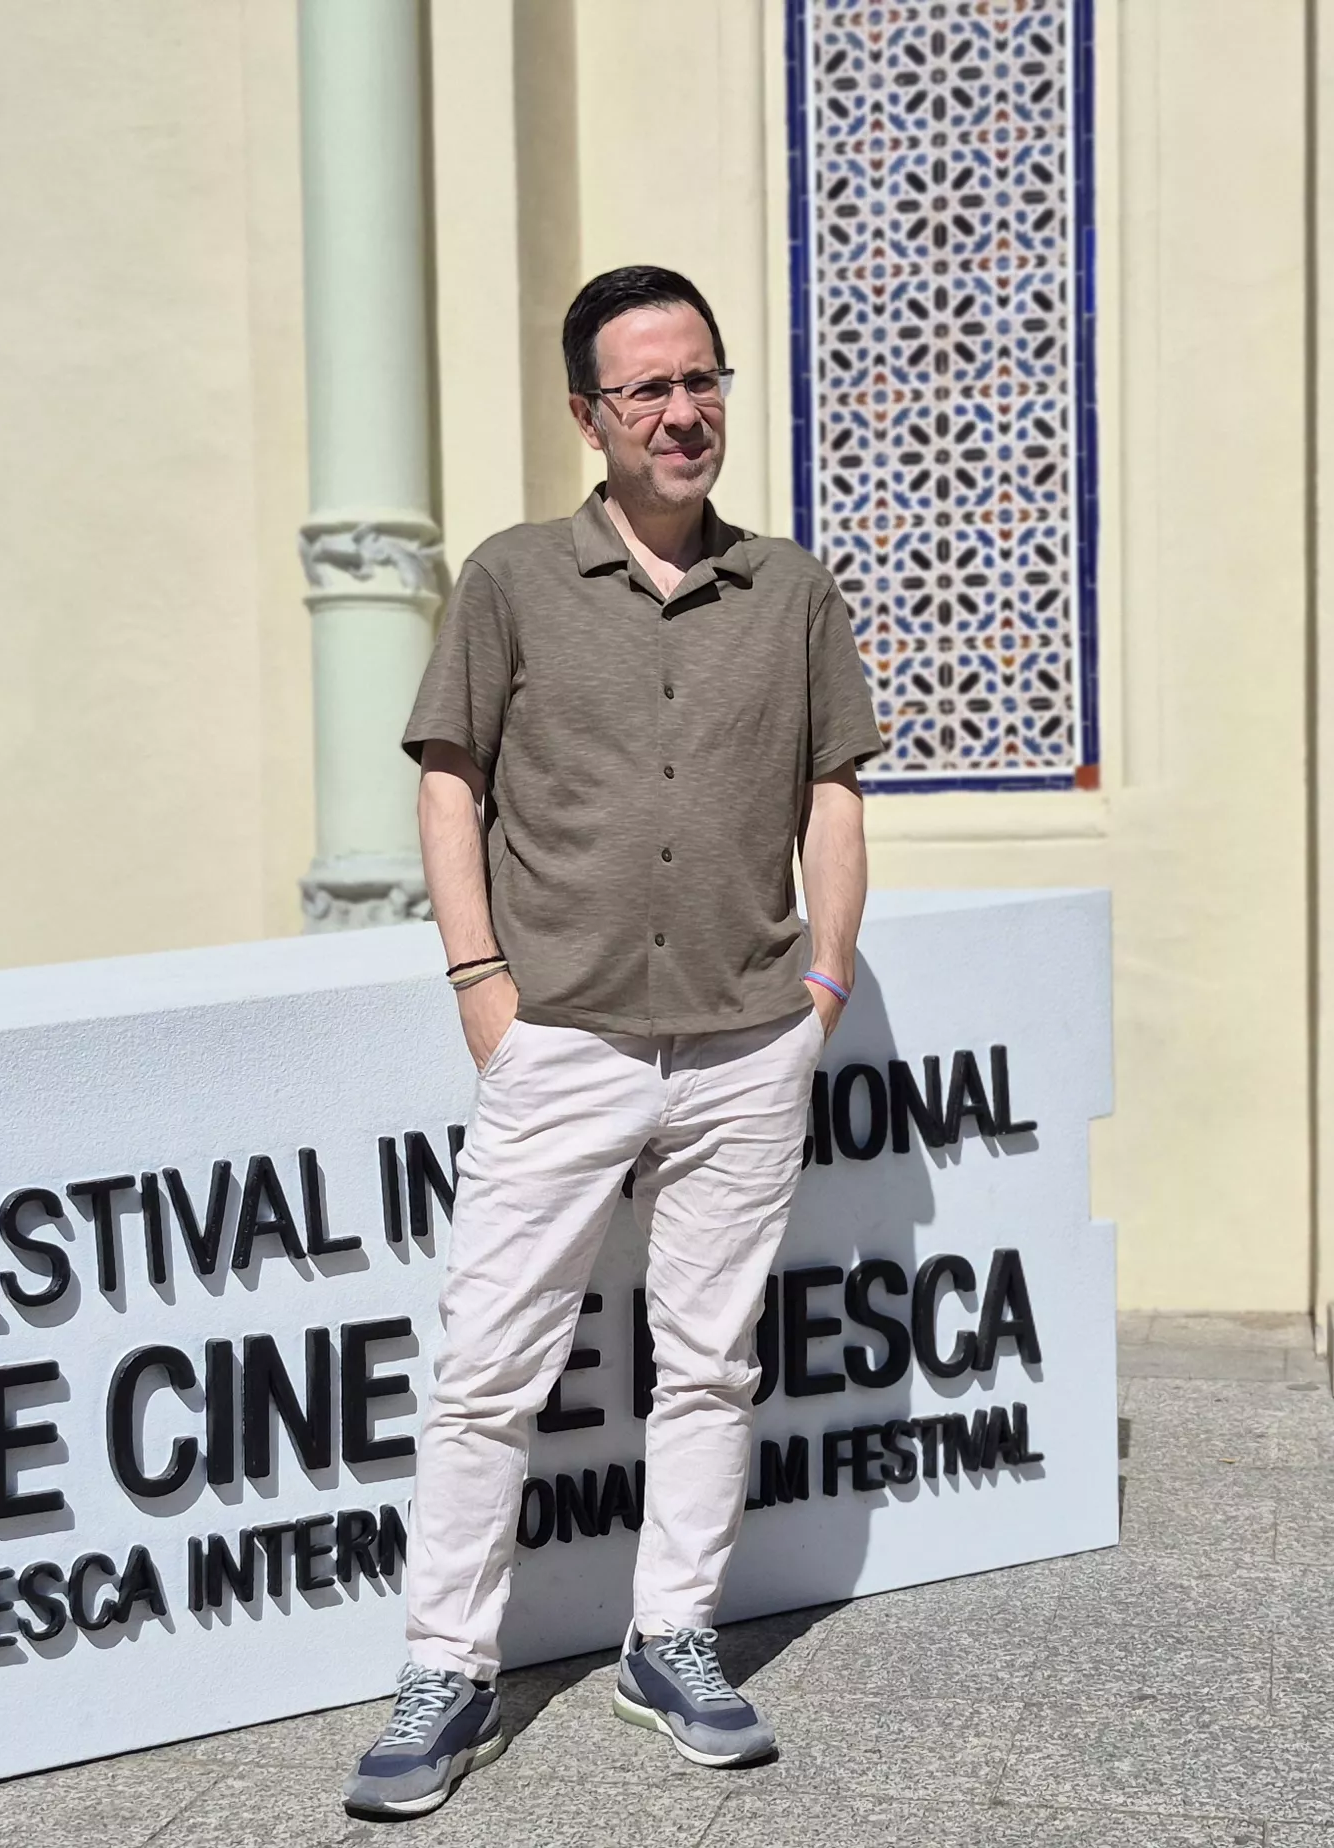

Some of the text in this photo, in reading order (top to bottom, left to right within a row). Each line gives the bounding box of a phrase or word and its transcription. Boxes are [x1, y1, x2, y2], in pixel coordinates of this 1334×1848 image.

[378, 1044, 1038, 1243] INIONAL
[105, 1315, 416, 1499] CINE
[822, 1401, 1045, 1498] FESTIVAL
